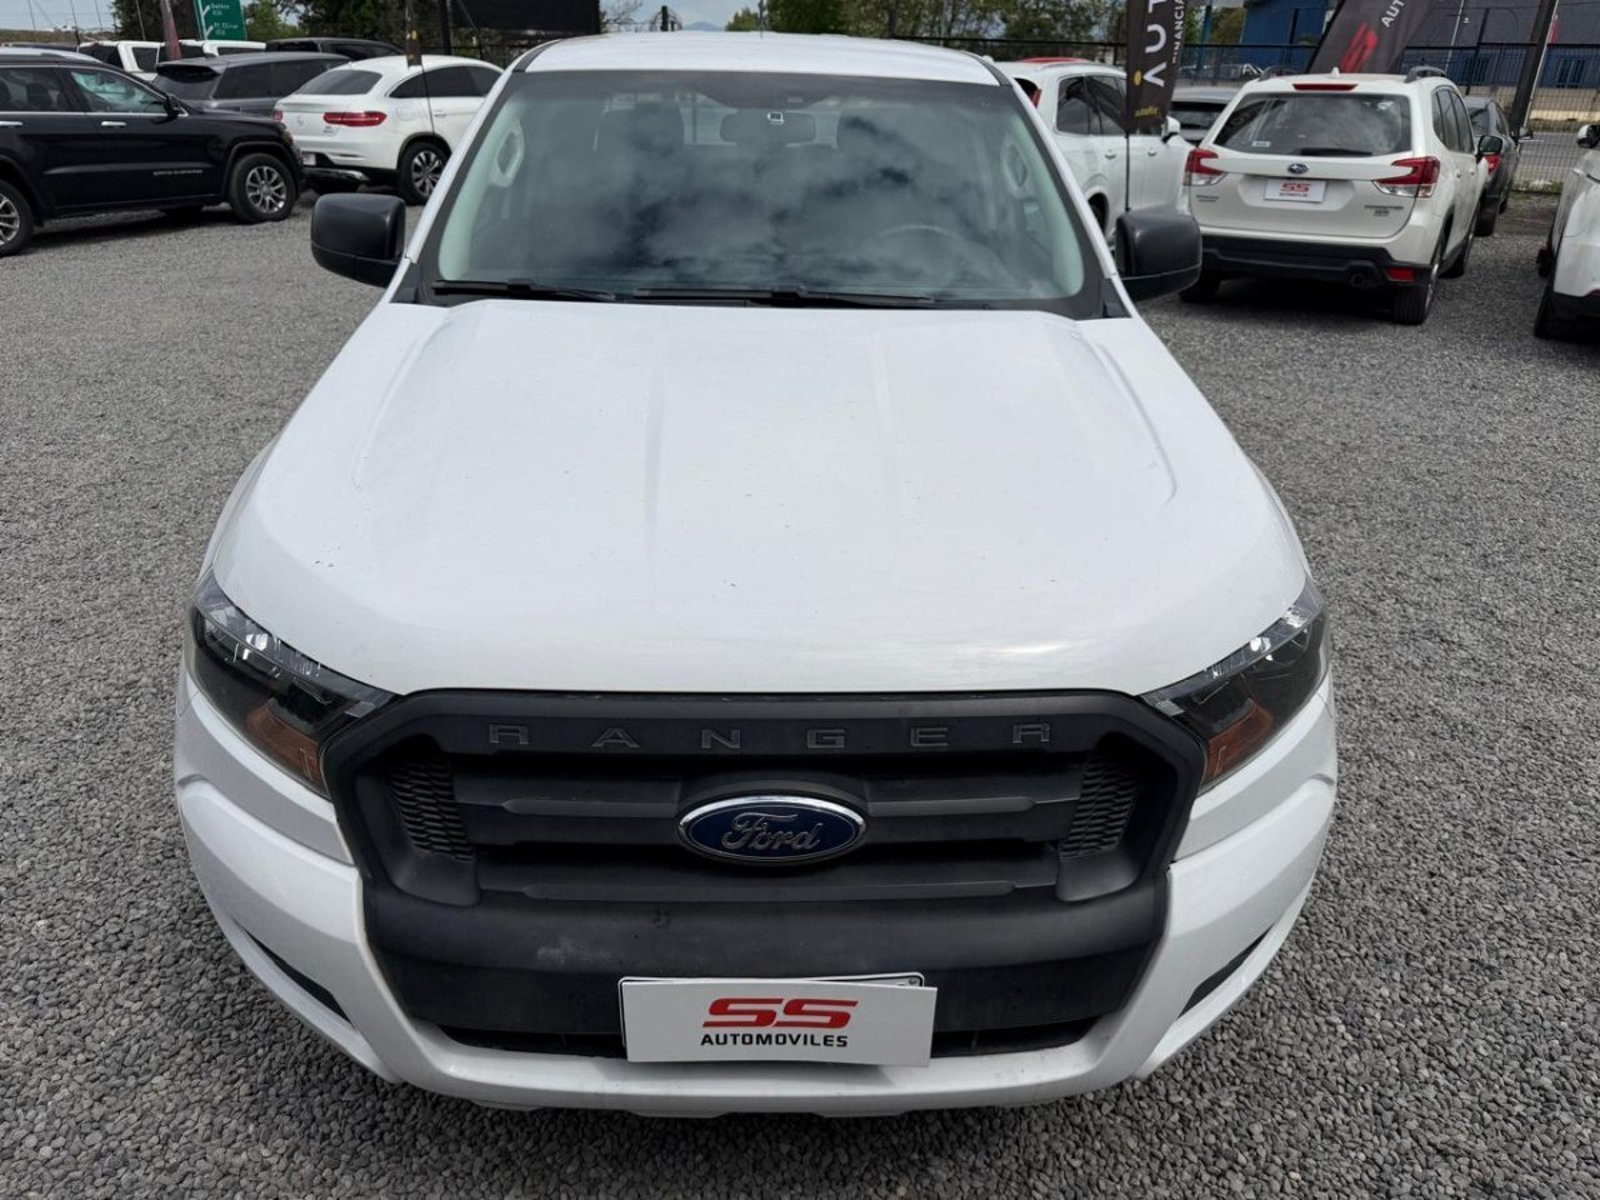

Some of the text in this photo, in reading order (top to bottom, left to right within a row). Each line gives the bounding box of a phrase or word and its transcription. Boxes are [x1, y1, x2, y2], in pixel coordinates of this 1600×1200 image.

[1381, 0, 1405, 28] AUT
[489, 723, 1051, 749] RANGER
[721, 811, 820, 852] Ford
[702, 998, 858, 1029] SS
[700, 1033, 848, 1047] AUTOMOVILES
